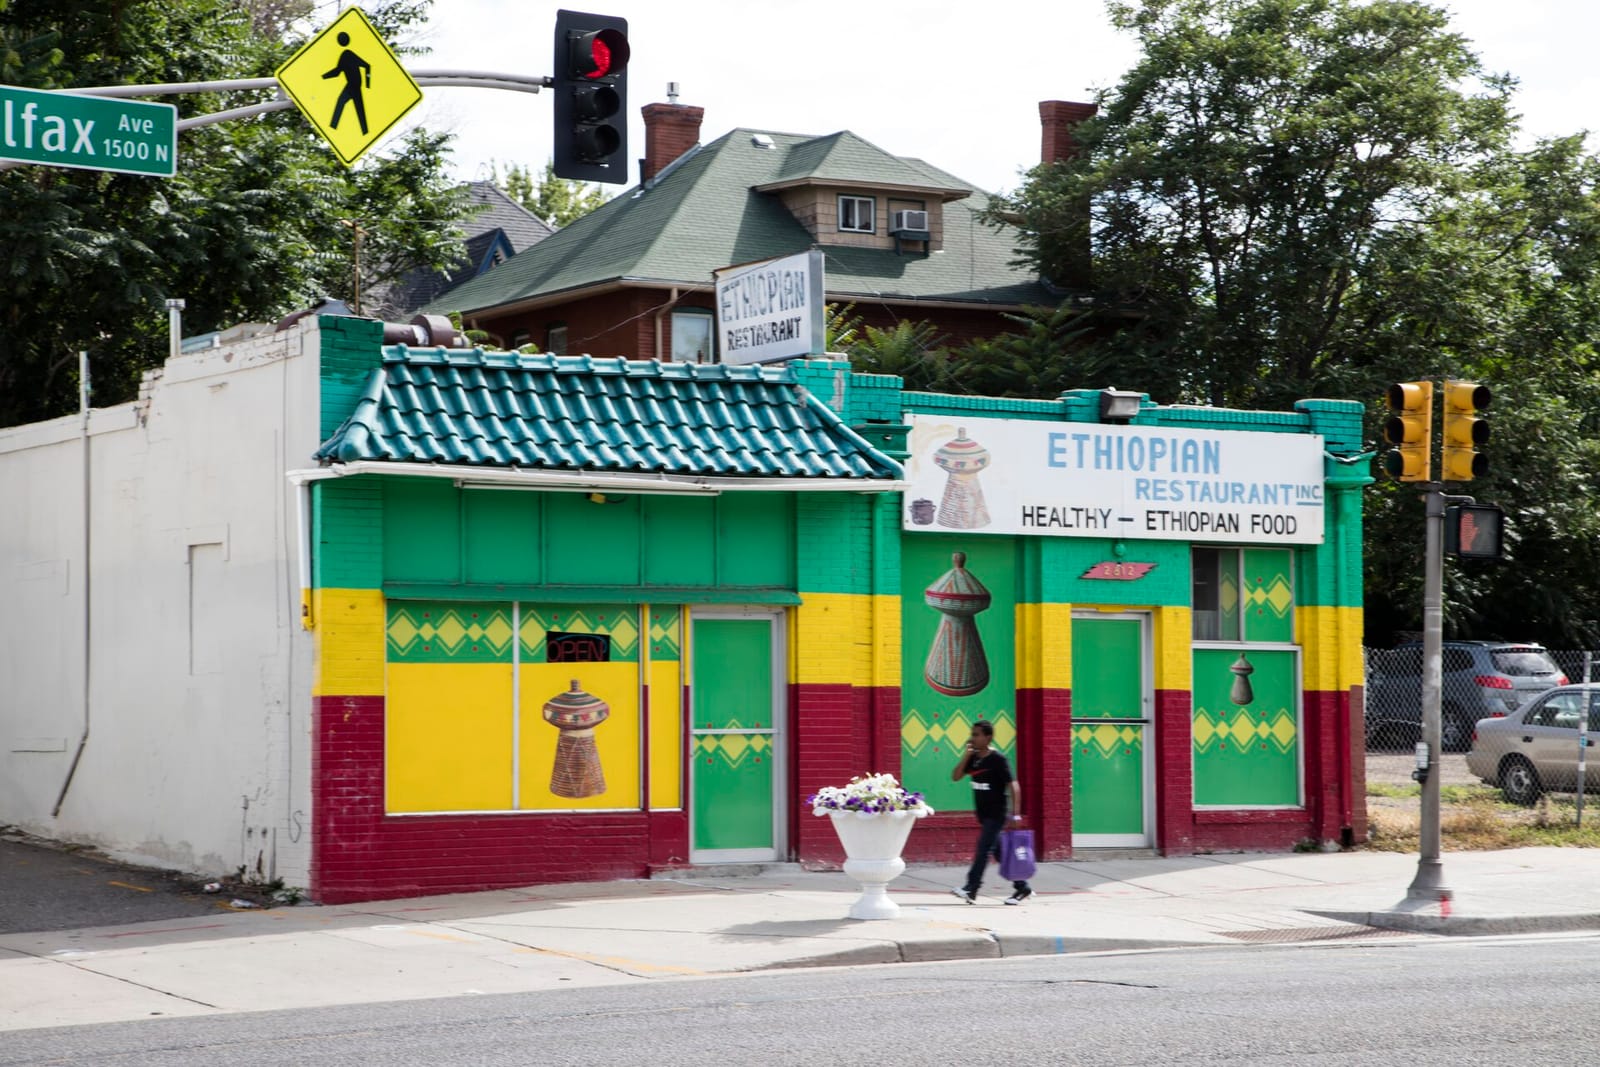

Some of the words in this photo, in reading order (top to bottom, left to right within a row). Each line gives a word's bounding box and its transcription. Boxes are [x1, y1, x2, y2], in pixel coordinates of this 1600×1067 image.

[118, 114, 153, 134] Ave
[103, 138, 149, 160] 1500
[155, 144, 168, 162] N
[721, 270, 805, 322] ETHIOPIAN
[727, 316, 802, 351] RESTAURANT
[1048, 432, 1220, 474] ETHIOPIAN
[1135, 478, 1293, 505] RESTAURANT
[1022, 505, 1112, 529] HEALTHY
[1146, 510, 1239, 533] ETHIOPIAN
[1251, 514, 1297, 535] FOOD
[548, 640, 604, 662] OPEN
